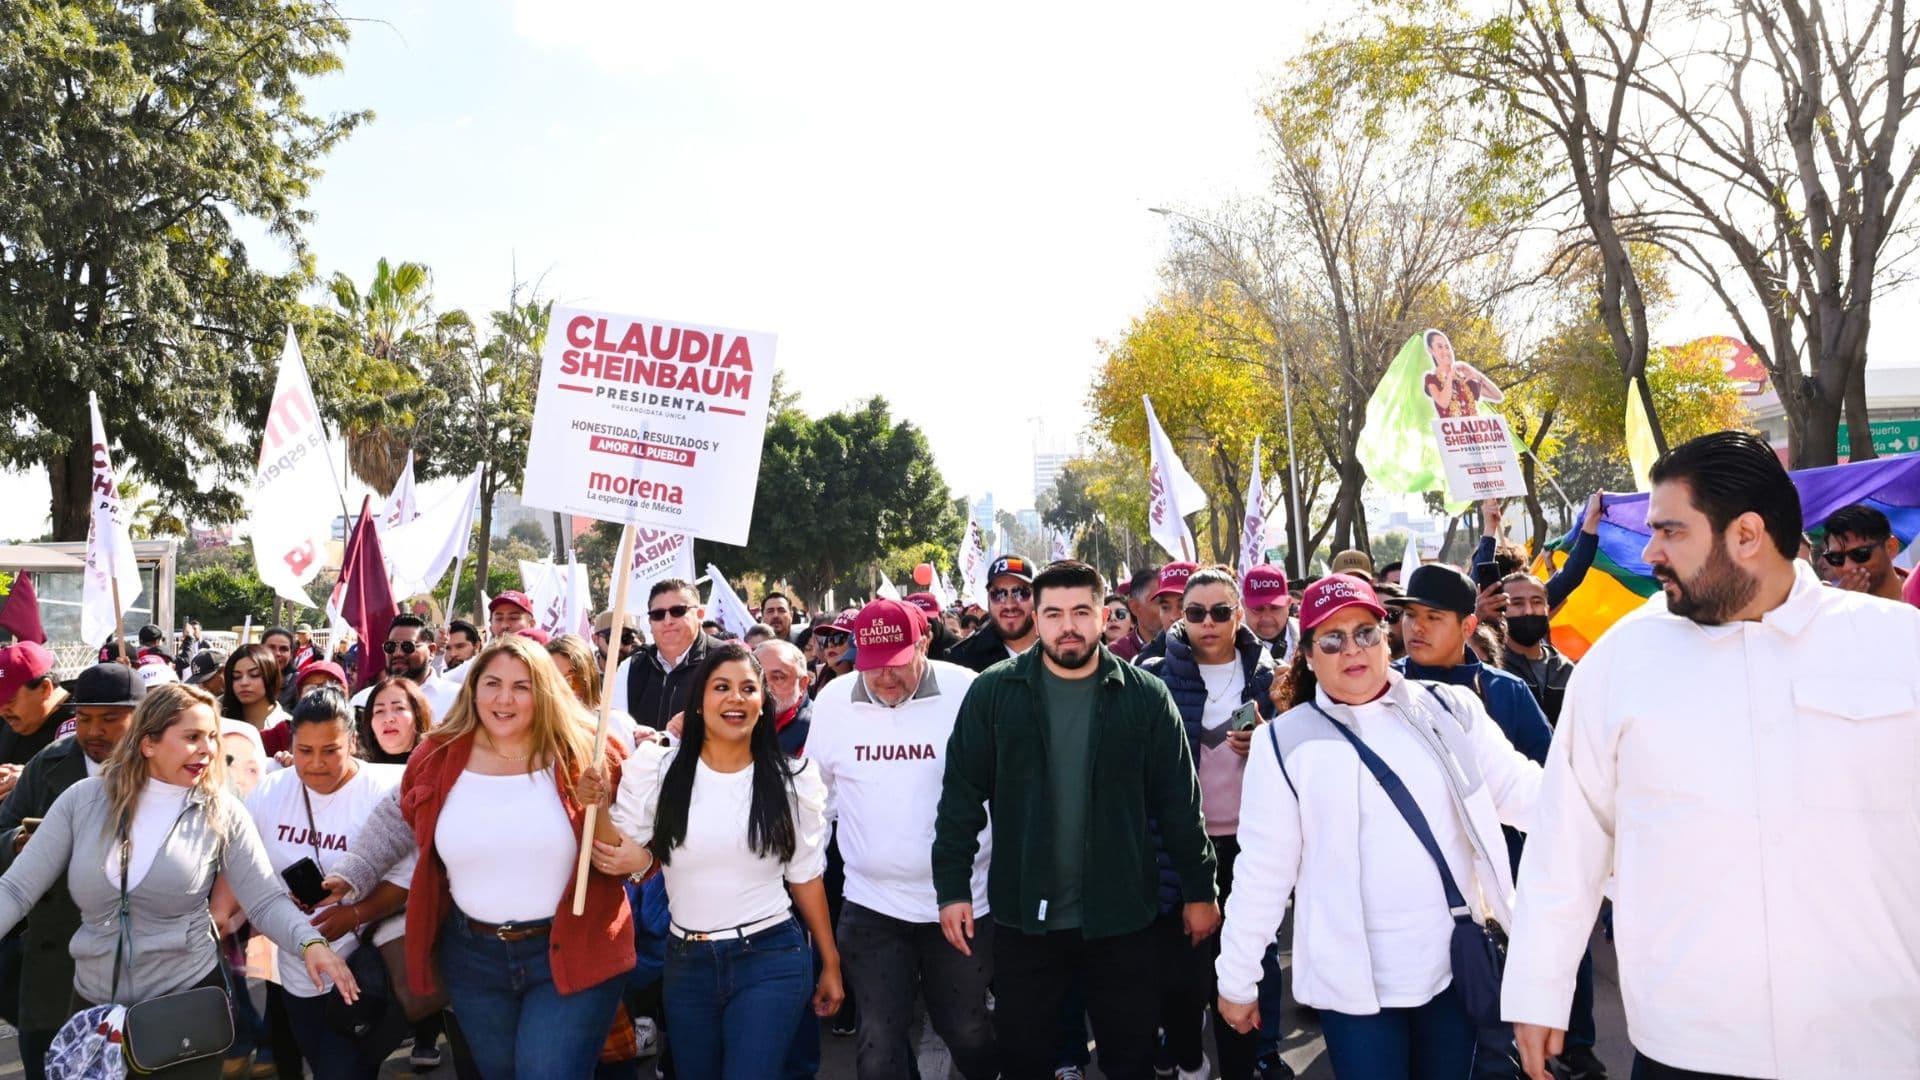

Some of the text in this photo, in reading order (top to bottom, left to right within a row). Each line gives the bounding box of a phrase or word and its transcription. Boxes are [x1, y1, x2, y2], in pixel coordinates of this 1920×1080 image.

[566, 315, 753, 372] CLAUDIA
[560, 350, 752, 400] SHEINBAUM
[596, 386, 706, 413] PRESIDENTA
[571, 420, 720, 452] HONESTIDAD, RESULTADOS Y
[1441, 419, 1502, 435] CLAUDIA
[1444, 432, 1505, 446] SHEINBAUM
[597, 438, 688, 464] AMOR AL PUEBLO
[588, 471, 684, 505] morena
[1473, 479, 1505, 490] morena
[586, 490, 682, 515] La esperanza de México
[1314, 595, 1331, 608] con
[860, 625, 901, 636] CLAUDIA
[872, 617, 884, 626] ES
[869, 633, 904, 644] MONTSE
[855, 743, 936, 761] TIJUANA
[278, 824, 347, 852] TIJUANA
